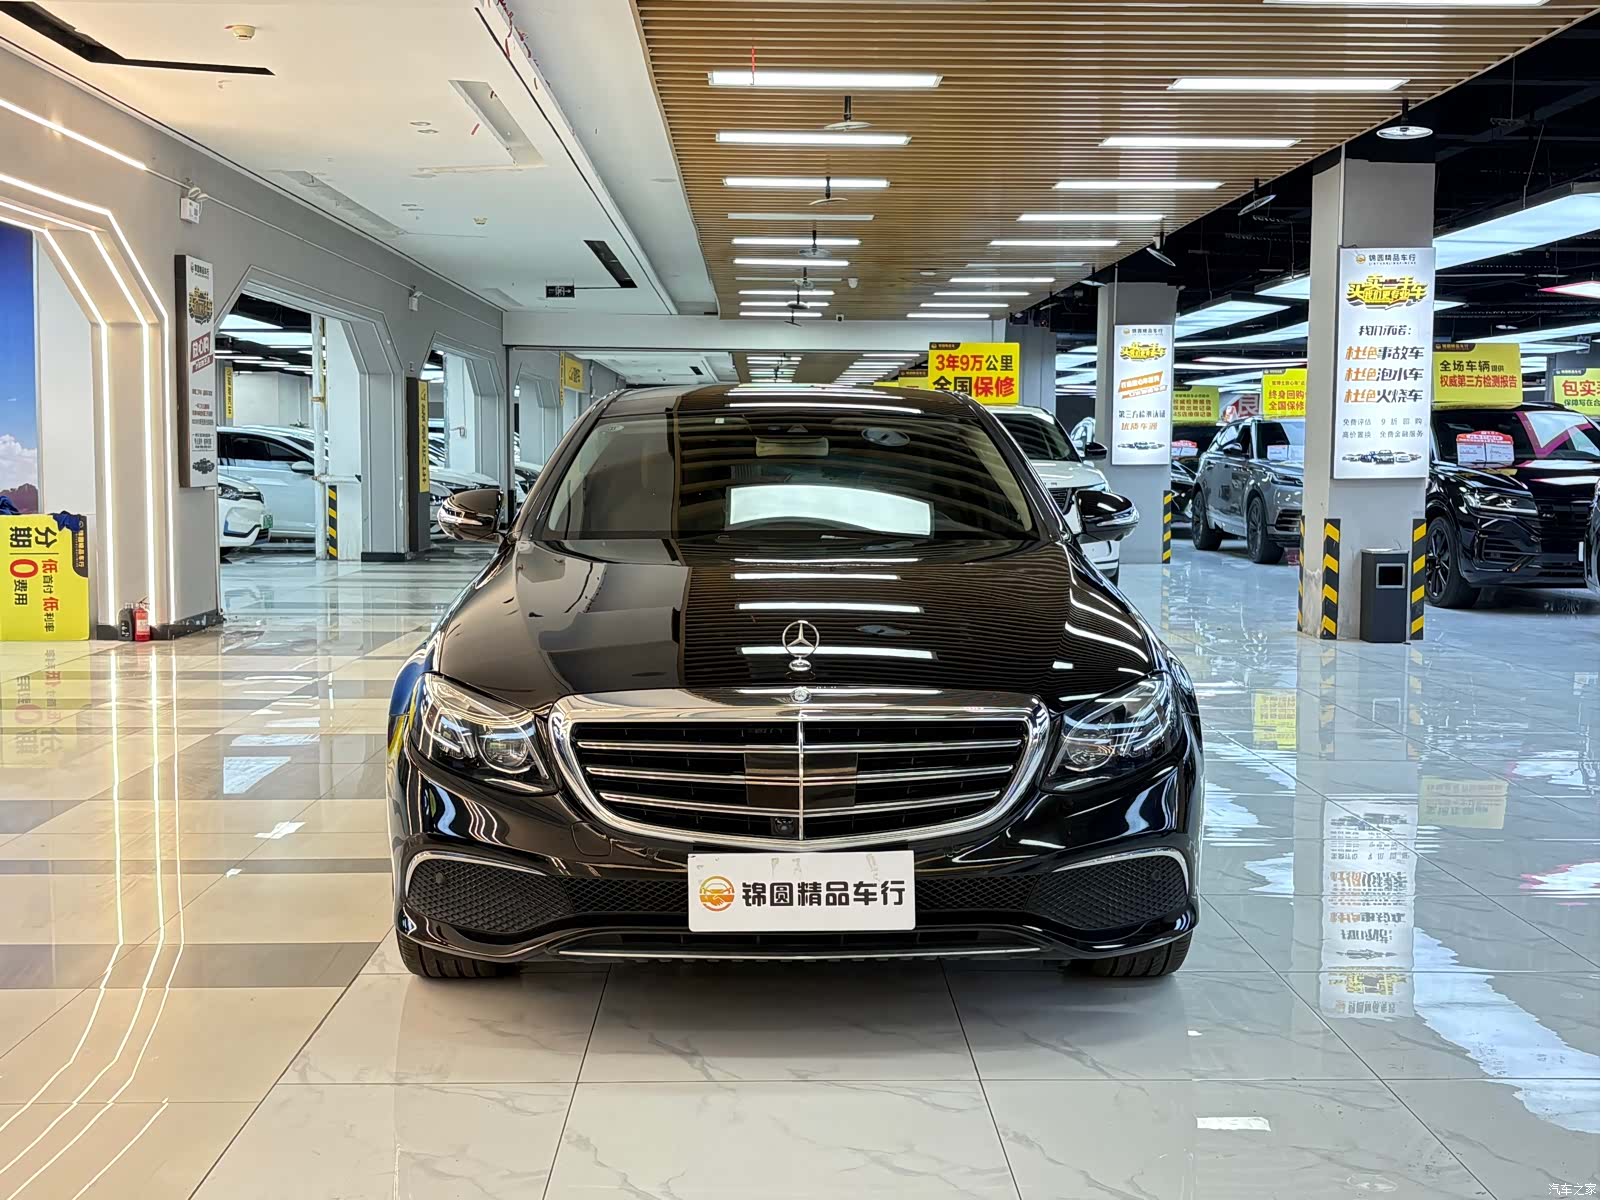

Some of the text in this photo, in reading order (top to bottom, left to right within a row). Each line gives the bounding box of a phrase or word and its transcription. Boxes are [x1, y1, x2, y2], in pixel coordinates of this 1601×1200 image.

[1345, 346, 1424, 360] 杜绝事故车
[935, 354, 1014, 372] 3年9万公里
[1344, 367, 1424, 381] 杜绝泡水车
[1440, 374, 1518, 388] 权威第三方检测报告
[932, 375, 1015, 397] 全国保修
[1562, 379, 1600, 397] 包实
[1268, 389, 1304, 399] 终身回购
[1343, 388, 1424, 403] 杜绝火烧车
[1268, 400, 1304, 411] 全国保修
[9, 526, 58, 549] 分期
[742, 880, 906, 907] 锦圆精品车行
